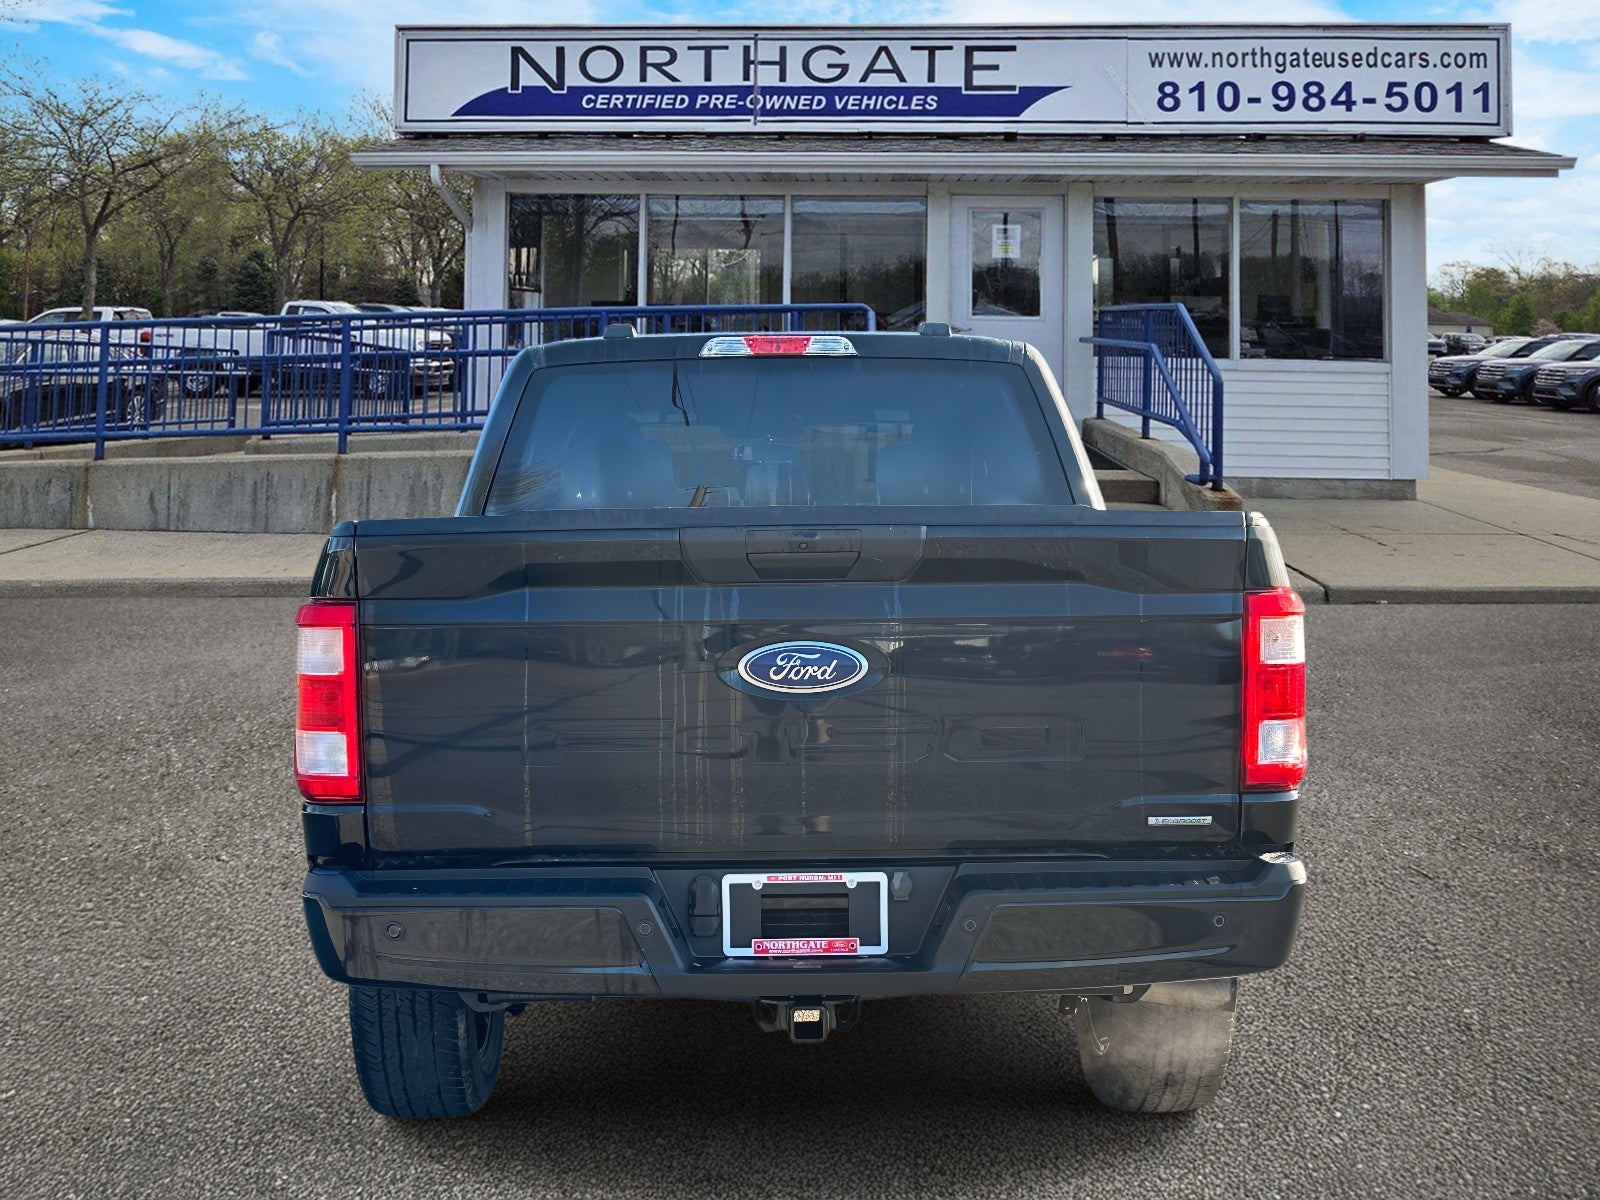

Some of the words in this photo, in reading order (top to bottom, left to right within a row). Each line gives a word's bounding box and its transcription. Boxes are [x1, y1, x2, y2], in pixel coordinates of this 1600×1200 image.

[509, 44, 1017, 92] NORTHGATE
[1148, 47, 1488, 73] www.northgateusedcars.com
[581, 94, 690, 110] CERTIFIED
[695, 94, 826, 110] PRE-OWNED
[834, 94, 938, 111] VEHICLES
[1156, 80, 1490, 113] 810-984-5011
[769, 652, 838, 681] Ford
[763, 941, 828, 949] NORTHGATE
